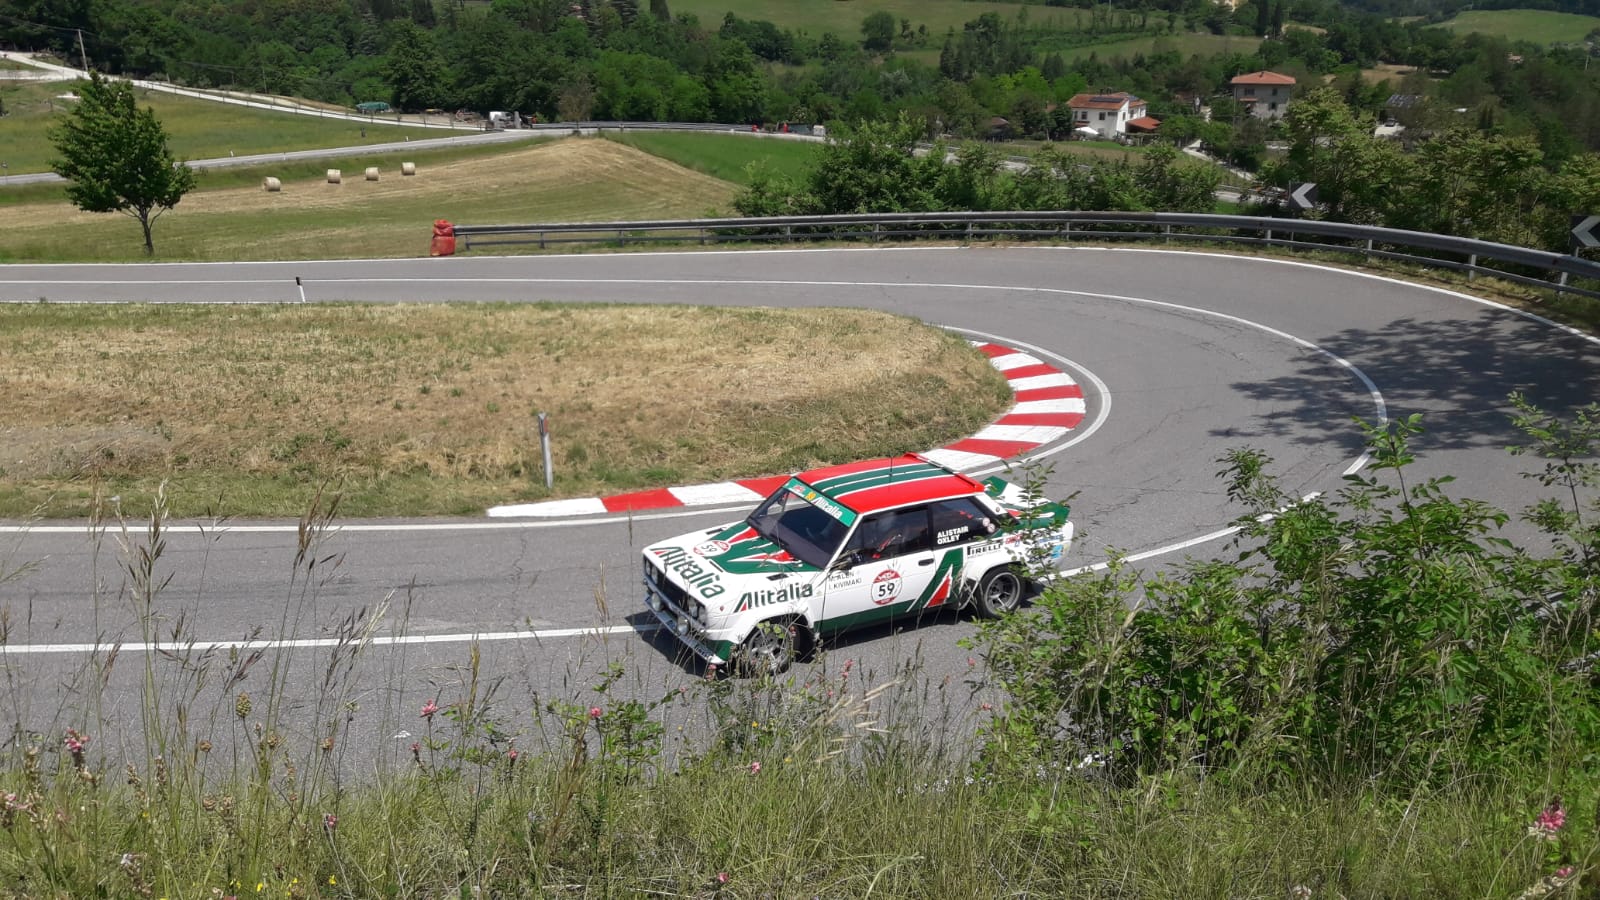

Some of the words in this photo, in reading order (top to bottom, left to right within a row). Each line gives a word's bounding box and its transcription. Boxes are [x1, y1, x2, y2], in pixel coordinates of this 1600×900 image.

[811, 497, 843, 519] Alitalia
[937, 525, 969, 539] ALISTAIR
[937, 535, 960, 545] OXLEY
[967, 539, 1003, 556] PIRELLI
[650, 546, 726, 599] Alitalia
[733, 582, 813, 613] Alitalia
[878, 582, 895, 597] 59
